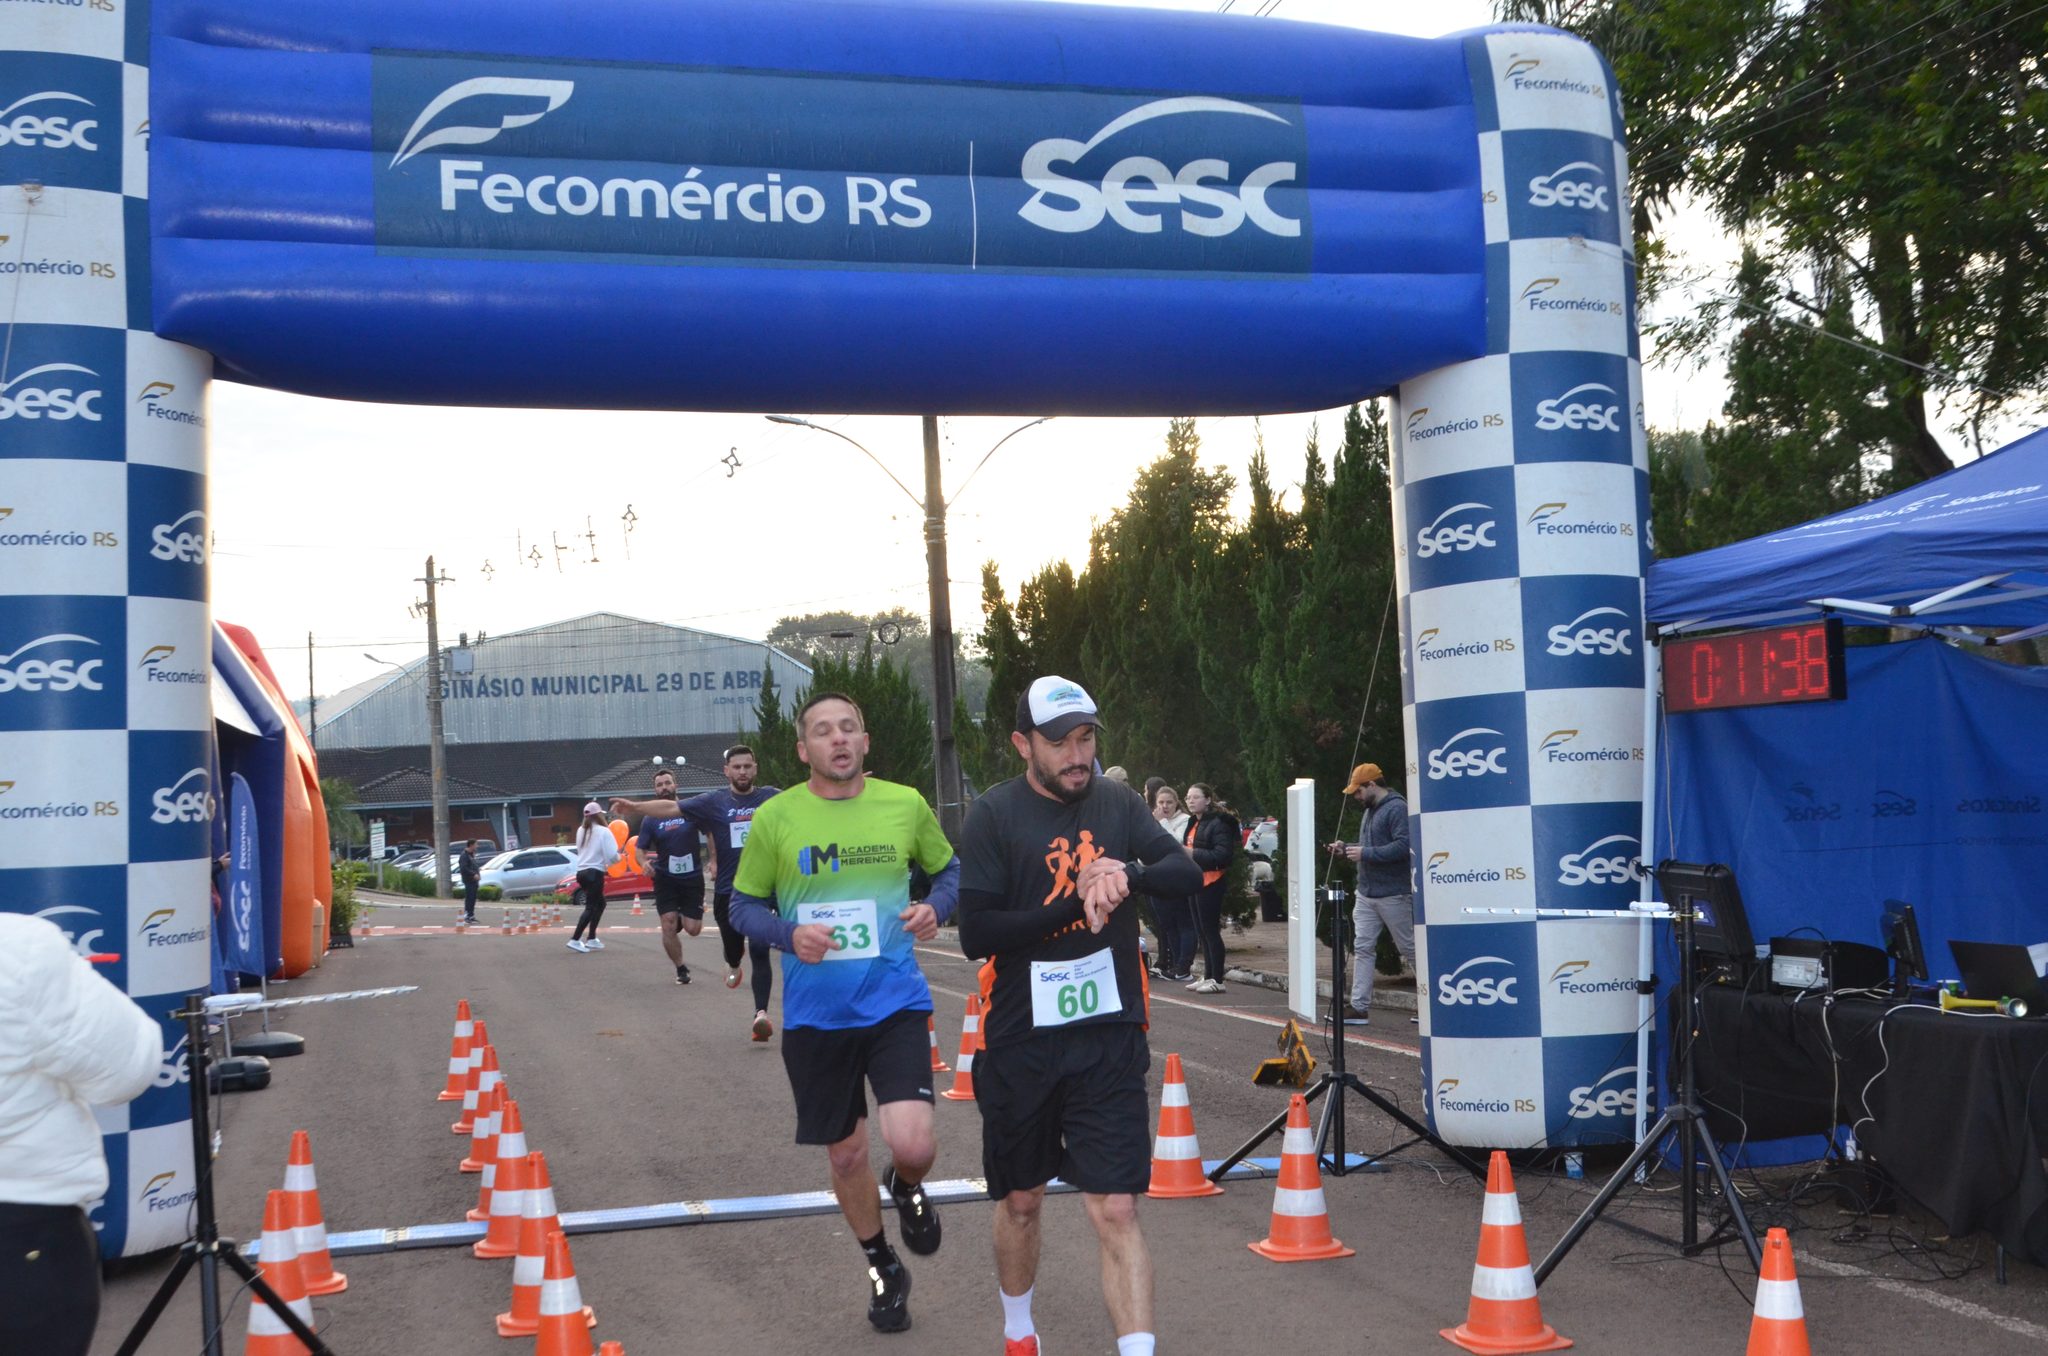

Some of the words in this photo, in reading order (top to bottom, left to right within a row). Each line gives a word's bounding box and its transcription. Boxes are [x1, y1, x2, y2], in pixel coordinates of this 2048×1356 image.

[1514, 77, 1590, 95] Fecomércio
[1591, 84, 1605, 99] RS
[440, 159, 825, 224] Fecomércio
[846, 176, 932, 228] RS
[1018, 138, 1301, 237] Sesc
[1529, 176, 1608, 212] Sesc
[90, 262, 116, 279] RS
[1530, 297, 1607, 313] Fecomércio
[1610, 302, 1623, 316] RS
[1535, 399, 1620, 432] Sesc
[1409, 418, 1478, 442] Fecomércio
[1483, 413, 1504, 428] RS
[93, 532, 118, 547] RS
[1417, 520, 1497, 558] Sesc
[1537, 521, 1617, 535] Fecomércio
[1620, 523, 1633, 536] RS
[1420, 642, 1489, 661] Fecomércio
[1494, 638, 1516, 652] RS
[1546, 624, 1632, 656] Sesc
[440, 675, 524, 699] GINÁSIO
[532, 674, 649, 696] MUNICIPAL
[656, 673, 683, 692] 29
[690, 671, 716, 691] DE
[1428, 747, 1508, 780] Sesc
[1548, 748, 1629, 763] Fecomércio
[94, 801, 119, 816] RS
[841, 844, 896, 855] ACADEMIA
[675, 863, 687, 872] 31
[841, 855, 897, 867] MERENCIO
[1430, 868, 1500, 884] Fecomércio
[1505, 867, 1526, 880] RS
[1040, 972, 1070, 982] Sesc
[1058, 980, 1098, 1018] 60
[1439, 974, 1518, 1005] Sesc
[1440, 1098, 1510, 1113] Fecomércio
[1514, 1099, 1536, 1112] RS
